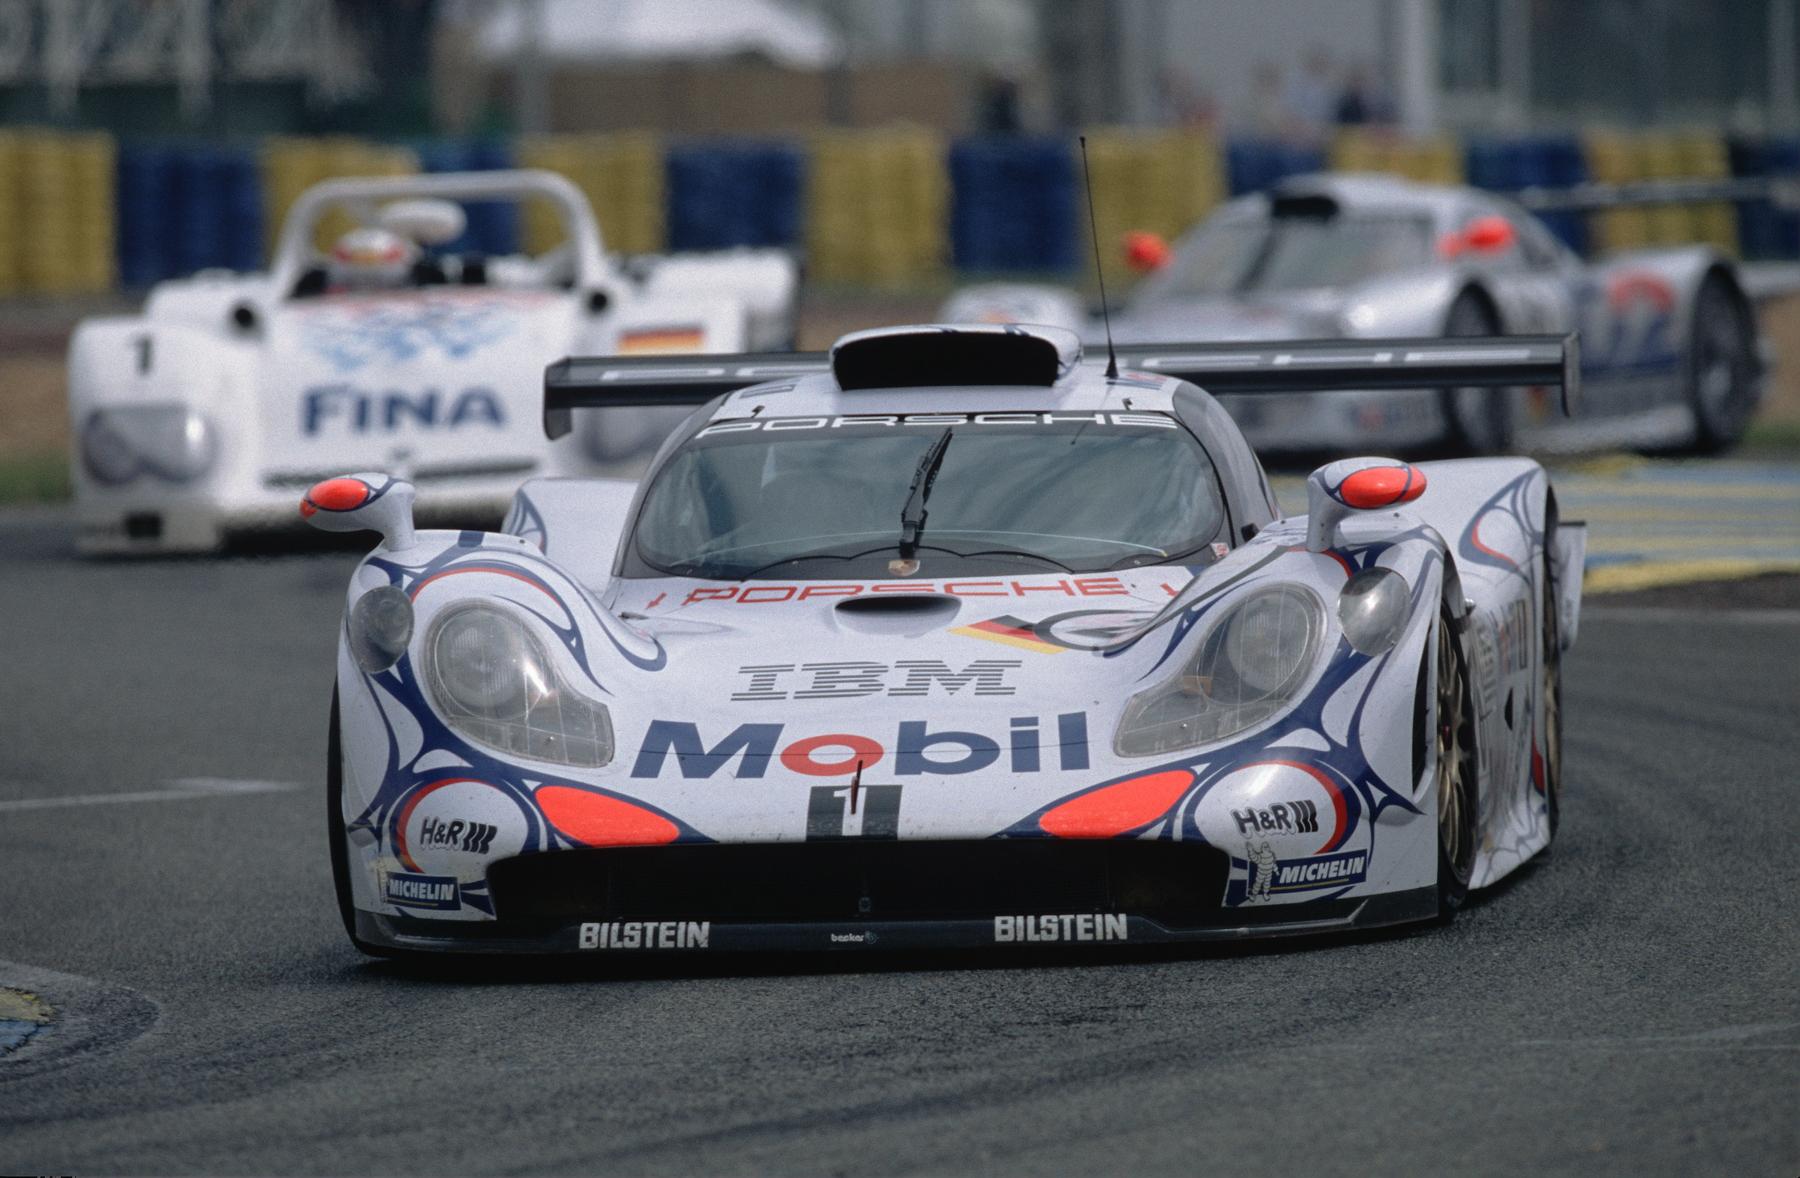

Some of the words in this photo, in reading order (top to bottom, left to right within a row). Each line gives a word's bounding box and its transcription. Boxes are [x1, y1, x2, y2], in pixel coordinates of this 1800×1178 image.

[303, 384, 507, 438] FINA
[695, 413, 1178, 440] PORSCHE
[681, 577, 1129, 606] PORSCHE
[730, 660, 1022, 701] IBM
[630, 711, 1091, 779] Mobil
[833, 786, 866, 837] 1
[1279, 856, 1365, 884] MICHELIN
[388, 879, 455, 901] MICHELIN
[579, 921, 710, 949] BILSTEIN
[993, 913, 1129, 942] BILSTEIN
